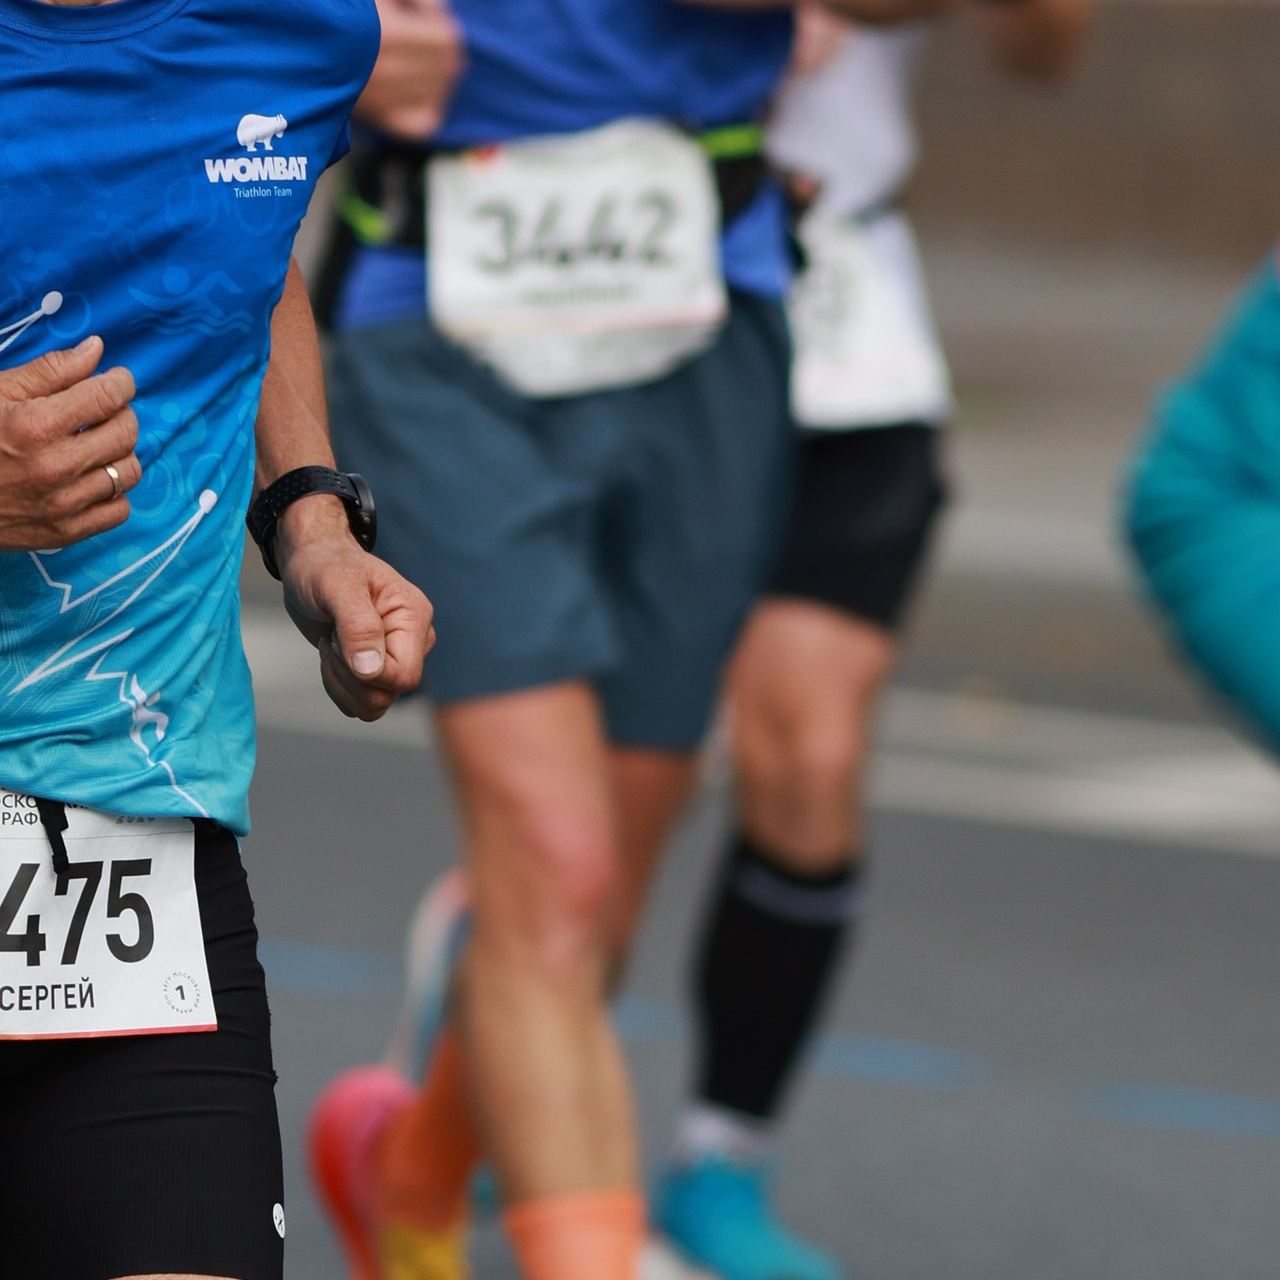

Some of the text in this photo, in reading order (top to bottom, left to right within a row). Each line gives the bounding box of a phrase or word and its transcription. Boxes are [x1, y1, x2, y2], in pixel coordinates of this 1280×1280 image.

[204, 156, 308, 183] WOMBAT
[233, 185, 293, 198] Triathlon Team
[472, 190, 680, 276] 3442
[175, 985, 186, 1001] 1
